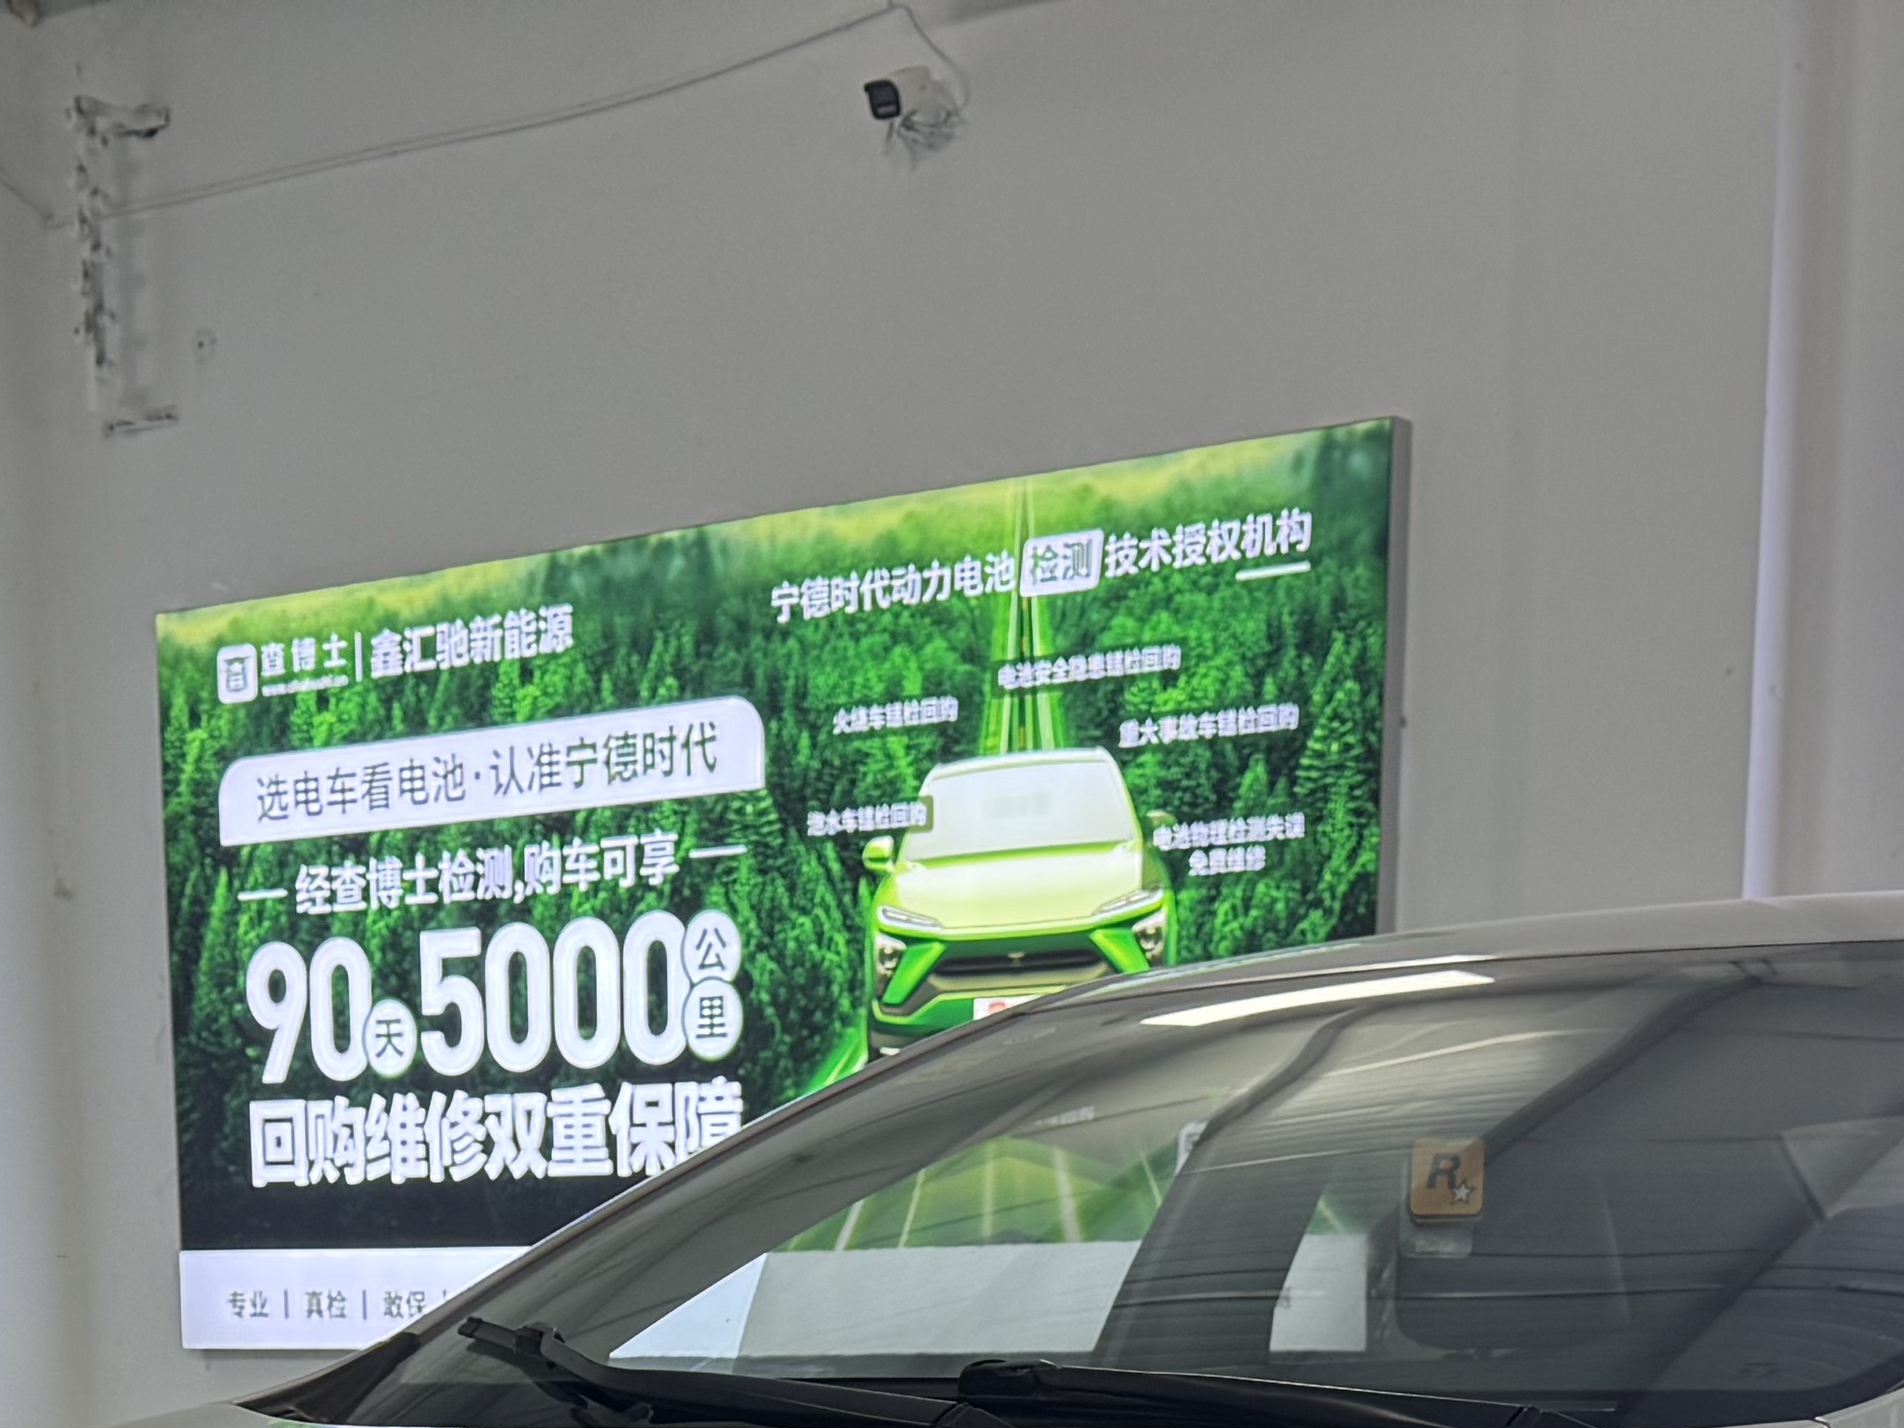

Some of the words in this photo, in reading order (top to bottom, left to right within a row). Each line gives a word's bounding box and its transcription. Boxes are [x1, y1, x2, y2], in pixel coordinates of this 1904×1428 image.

[370, 602, 574, 679] 鑫汇驰新能源
[250, 1075, 743, 1189] 回购维修双重保障
[1427, 1152, 1461, 1191] R
